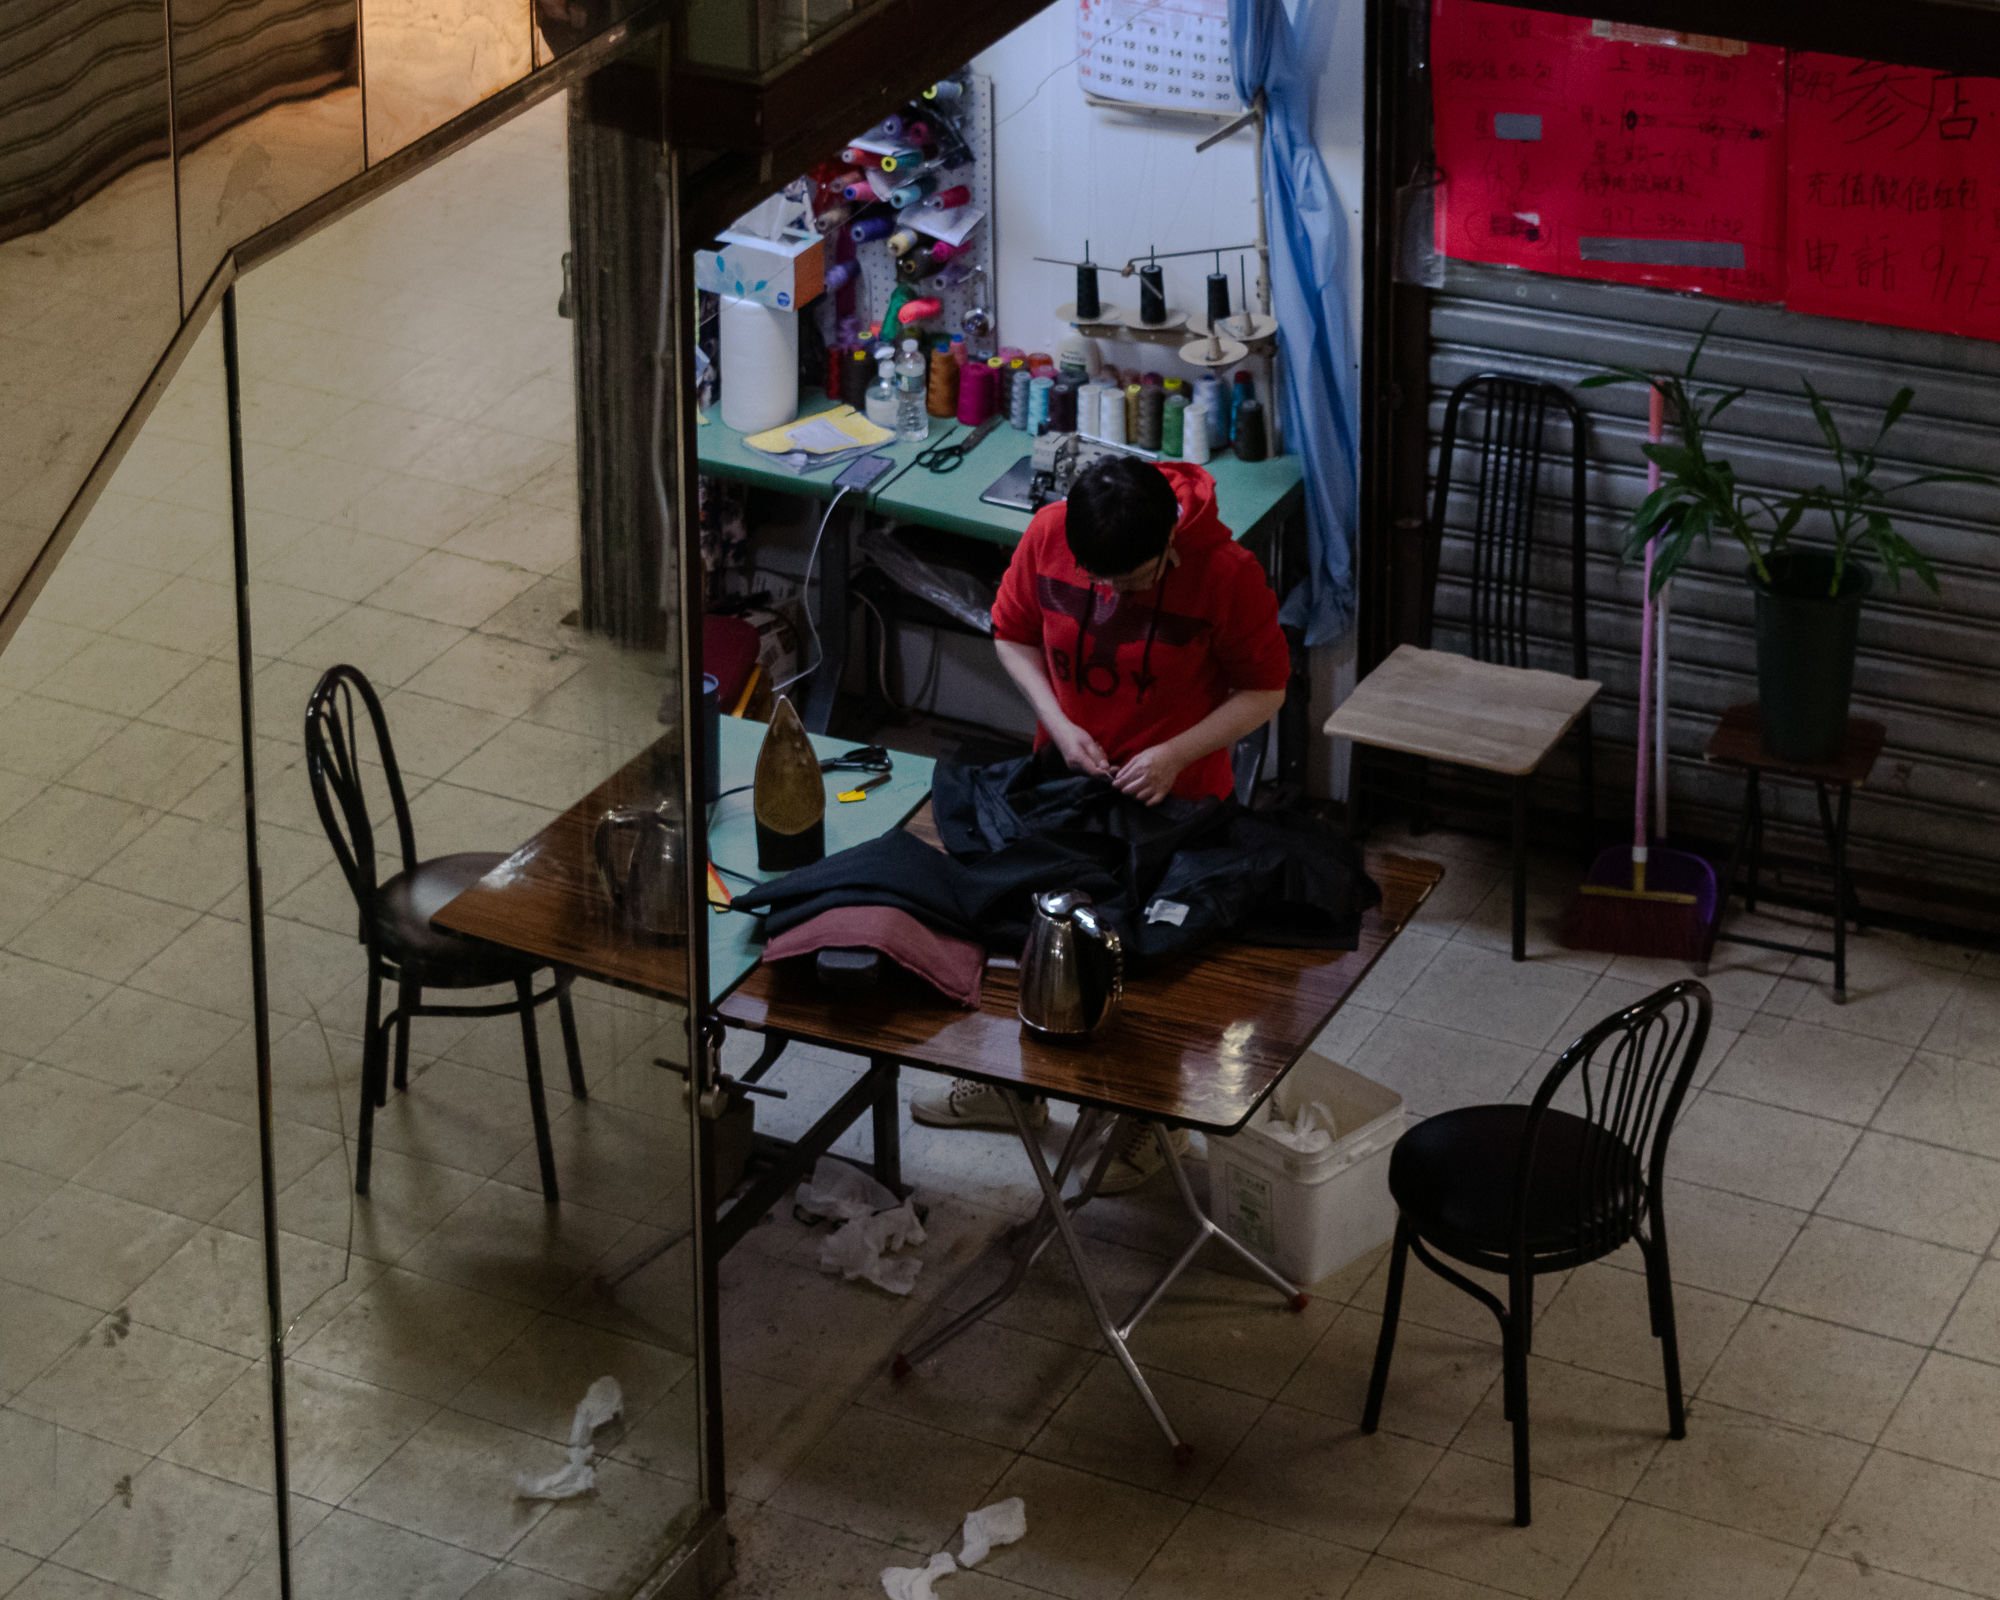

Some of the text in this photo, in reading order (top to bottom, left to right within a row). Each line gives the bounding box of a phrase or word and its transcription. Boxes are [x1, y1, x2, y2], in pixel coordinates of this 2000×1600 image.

[1101, 35, 1113, 46] 11
[1124, 40, 1136, 51] 12
[1146, 44, 1160, 55] 13
[1169, 48, 1183, 59] 14
[1193, 52, 1206, 63] 15
[1217, 56, 1230, 66] 16
[1101, 54, 1113, 65] 18
[1122, 58, 1136, 69] 19
[1145, 62, 1159, 73] 20
[1168, 66, 1181, 77] 21
[1191, 70, 1206, 81] 22
[1215, 74, 1231, 83] 23
[1099, 72, 1113, 83] 25
[1120, 77, 1135, 88] 26
[1144, 81, 1158, 92] 27
[1167, 85, 1182, 96] 28
[1191, 89, 1206, 99] 29
[1215, 92, 1231, 102] 30
